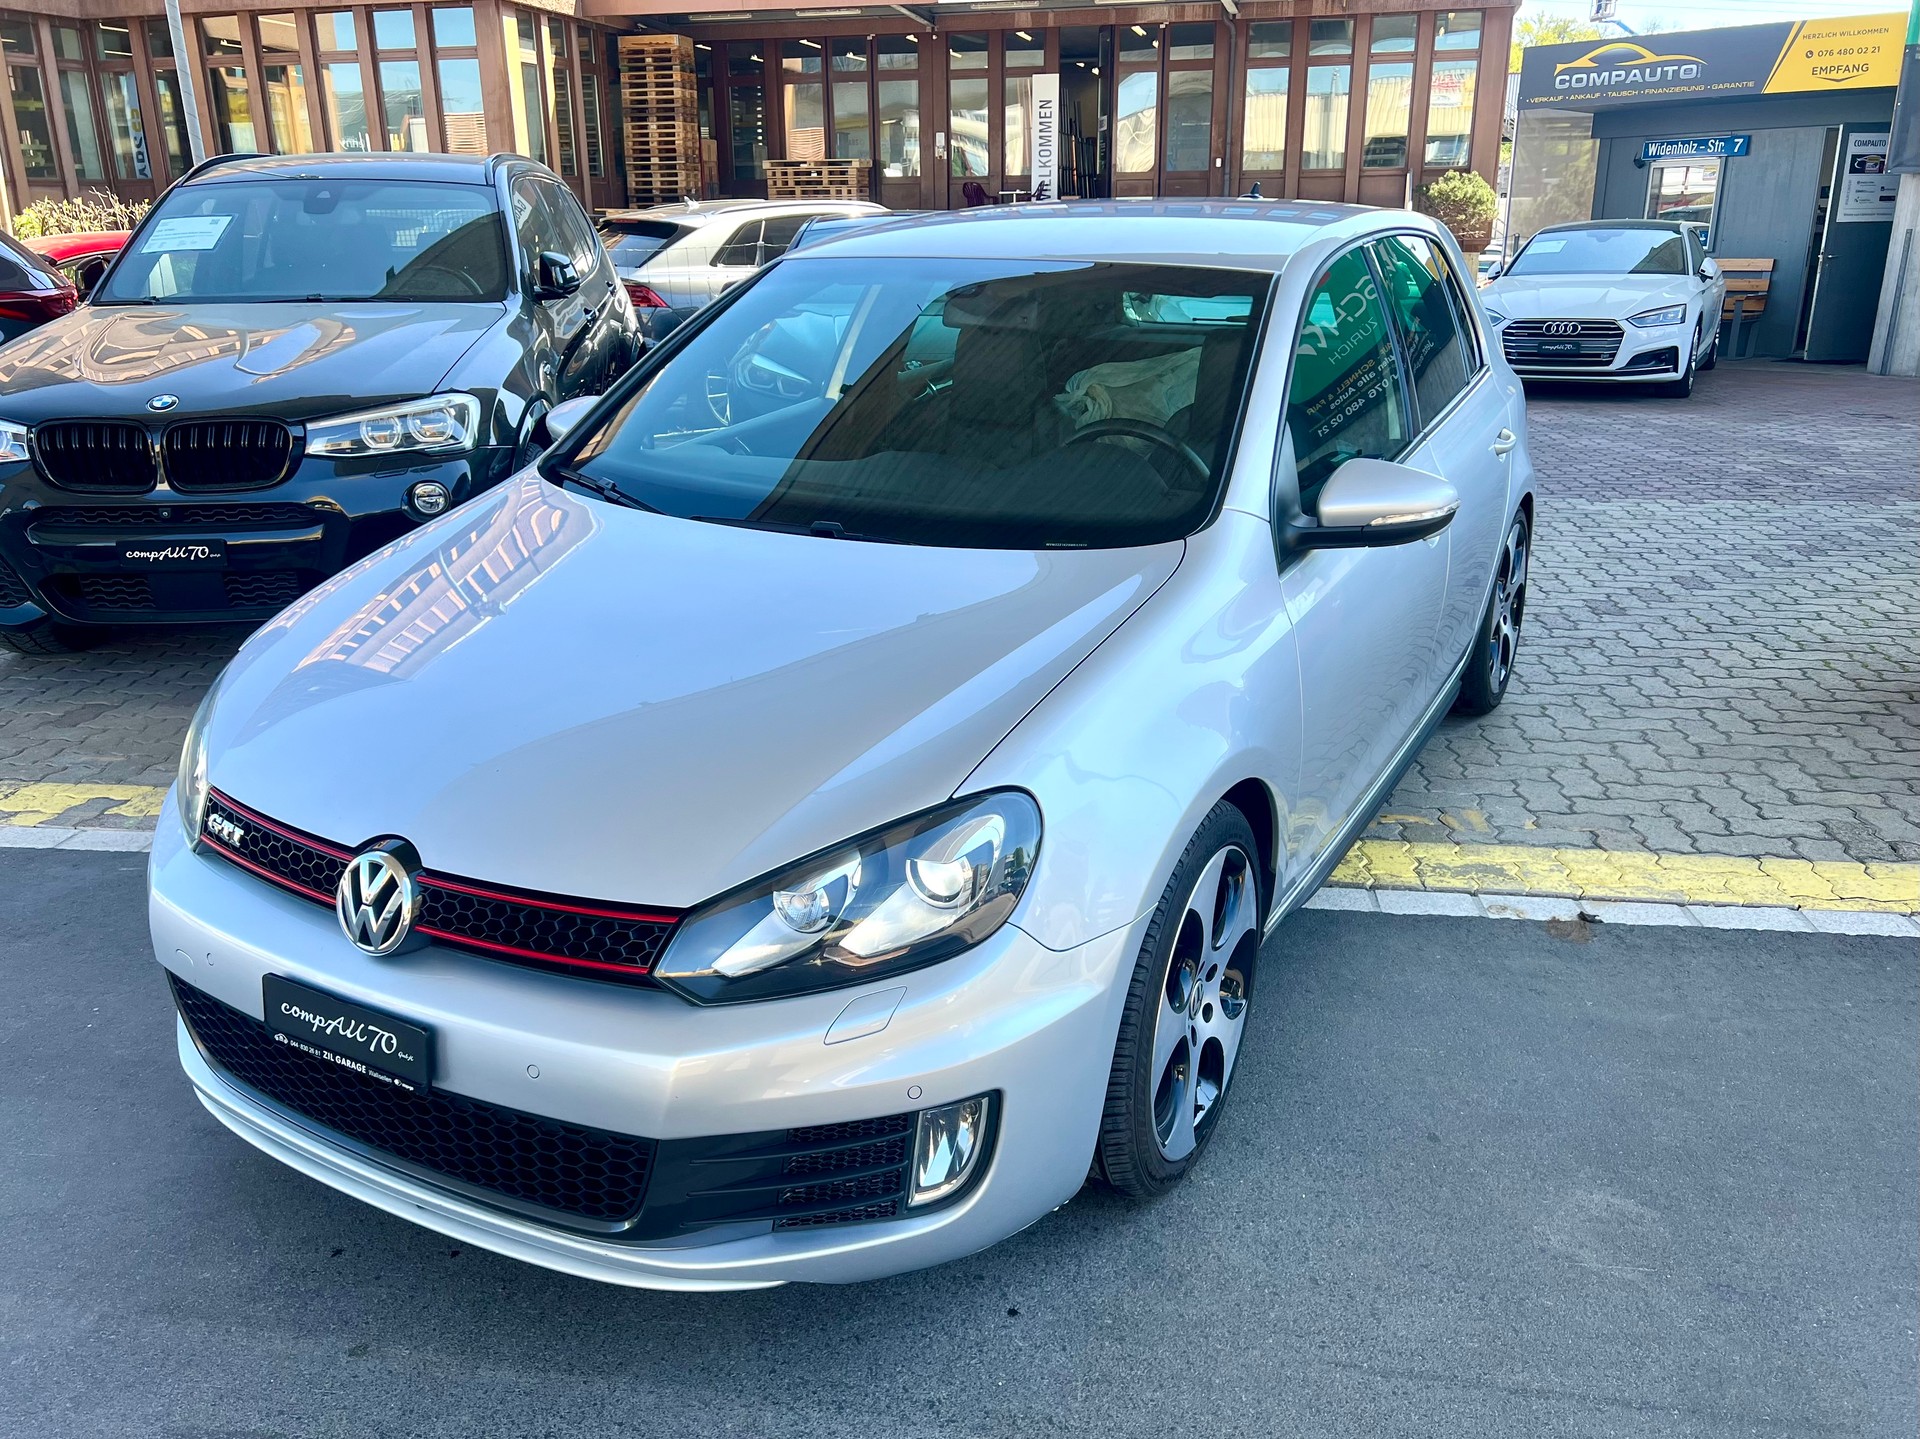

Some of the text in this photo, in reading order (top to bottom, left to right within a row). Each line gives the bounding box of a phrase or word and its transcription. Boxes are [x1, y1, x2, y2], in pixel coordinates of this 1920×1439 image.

[1802, 27, 1889, 40] HERZLICH WILLKOMMEN
[1817, 45, 1880, 57] 076 480 02 21
[1554, 64, 1698, 90] COMPAUTO
[1811, 63, 1869, 75] EMPFANG
[1529, 81, 1755, 104] VERKAUF ANKAUF TAUSCH FINANZIERUNG GARANTIE
[1648, 140, 1698, 156] Widenholz
[1707, 139, 1725, 153] Str.
[1733, 138, 1744, 153] 7
[208, 813, 245, 847] GTI
[322, 1050, 334, 1062] ZIL
[335, 1055, 367, 1074] GARAGE
